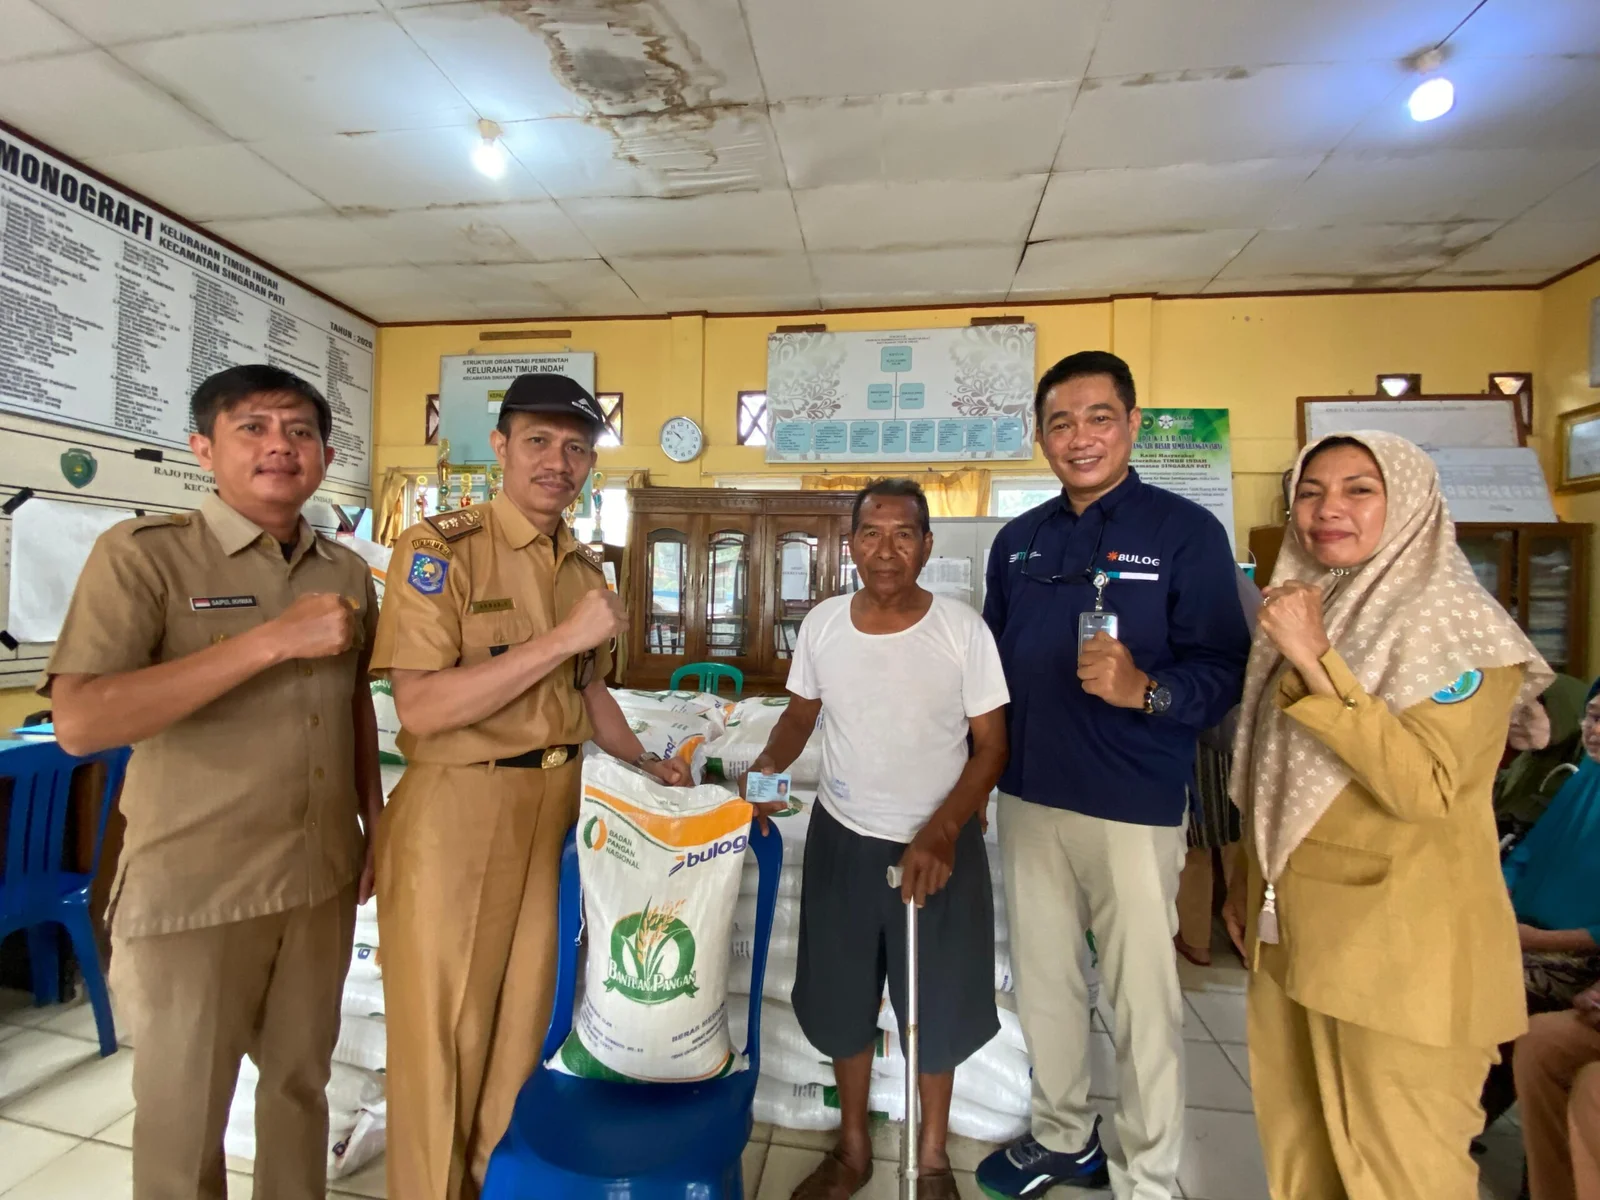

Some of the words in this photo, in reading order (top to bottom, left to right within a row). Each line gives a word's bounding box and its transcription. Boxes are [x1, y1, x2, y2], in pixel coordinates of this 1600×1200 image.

[0, 139, 153, 241] MONOGRAFI
[160, 222, 220, 260] KELURAHAN
[222, 253, 251, 277] TIMUR
[252, 270, 279, 291] INDAH
[159, 236, 220, 274] KECAMATAN
[221, 267, 267, 297] SINGARAN
[267, 290, 286, 306] PATI
[329, 321, 353, 339] TAHUN
[356, 335, 373, 350] 2020
[466, 366, 513, 374] KELURAHAN
[515, 365, 539, 373] TIMUR
[154, 466, 181, 478] RAJO
[183, 472, 216, 484] PENGH
[1118, 553, 1160, 567] BULOG
[607, 837, 636, 858] PANGAN
[609, 829, 632, 847] BADAN
[605, 846, 640, 870] NASIONAL
[687, 835, 748, 867] bulog
[653, 970, 697, 992] PANGAN
